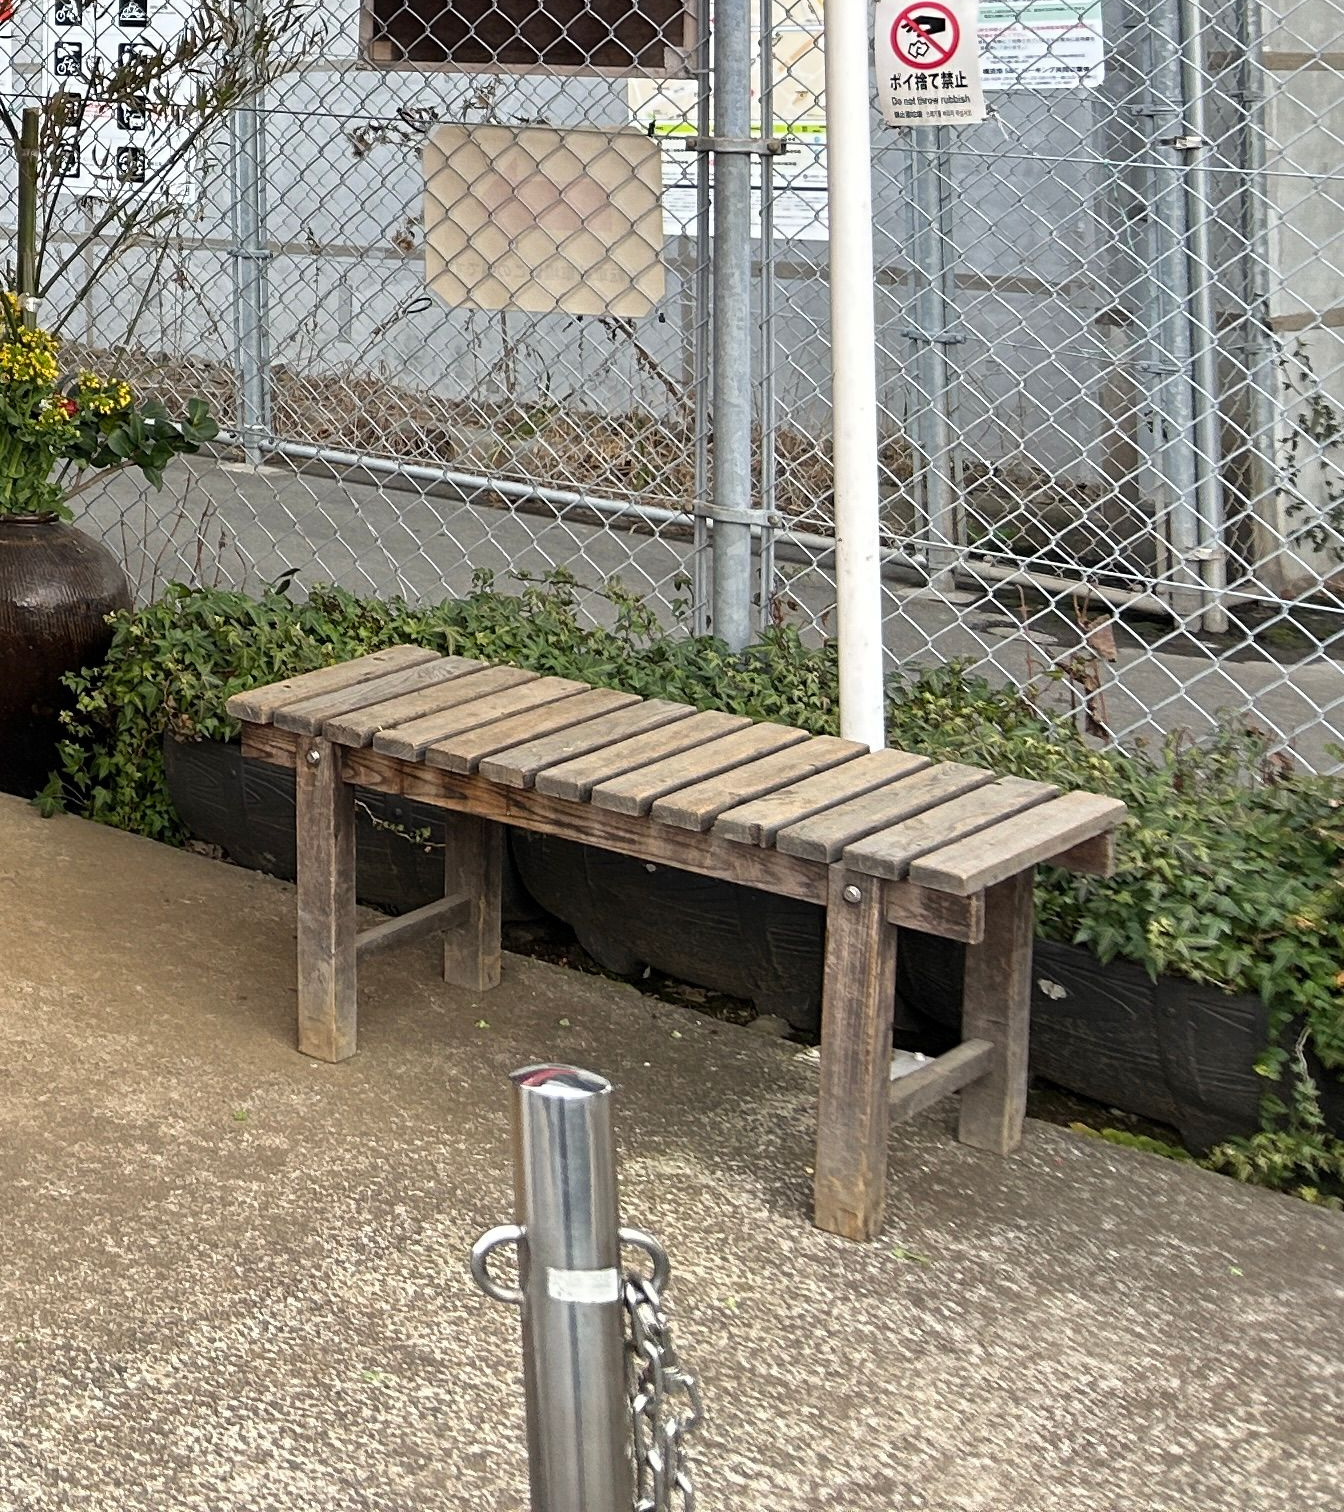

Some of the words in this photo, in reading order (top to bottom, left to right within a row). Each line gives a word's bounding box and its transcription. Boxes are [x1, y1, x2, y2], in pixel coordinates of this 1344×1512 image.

[889, 70, 969, 91] ポイ捨て禁止
[891, 96, 903, 106] Do
[940, 94, 971, 105] rubbish
